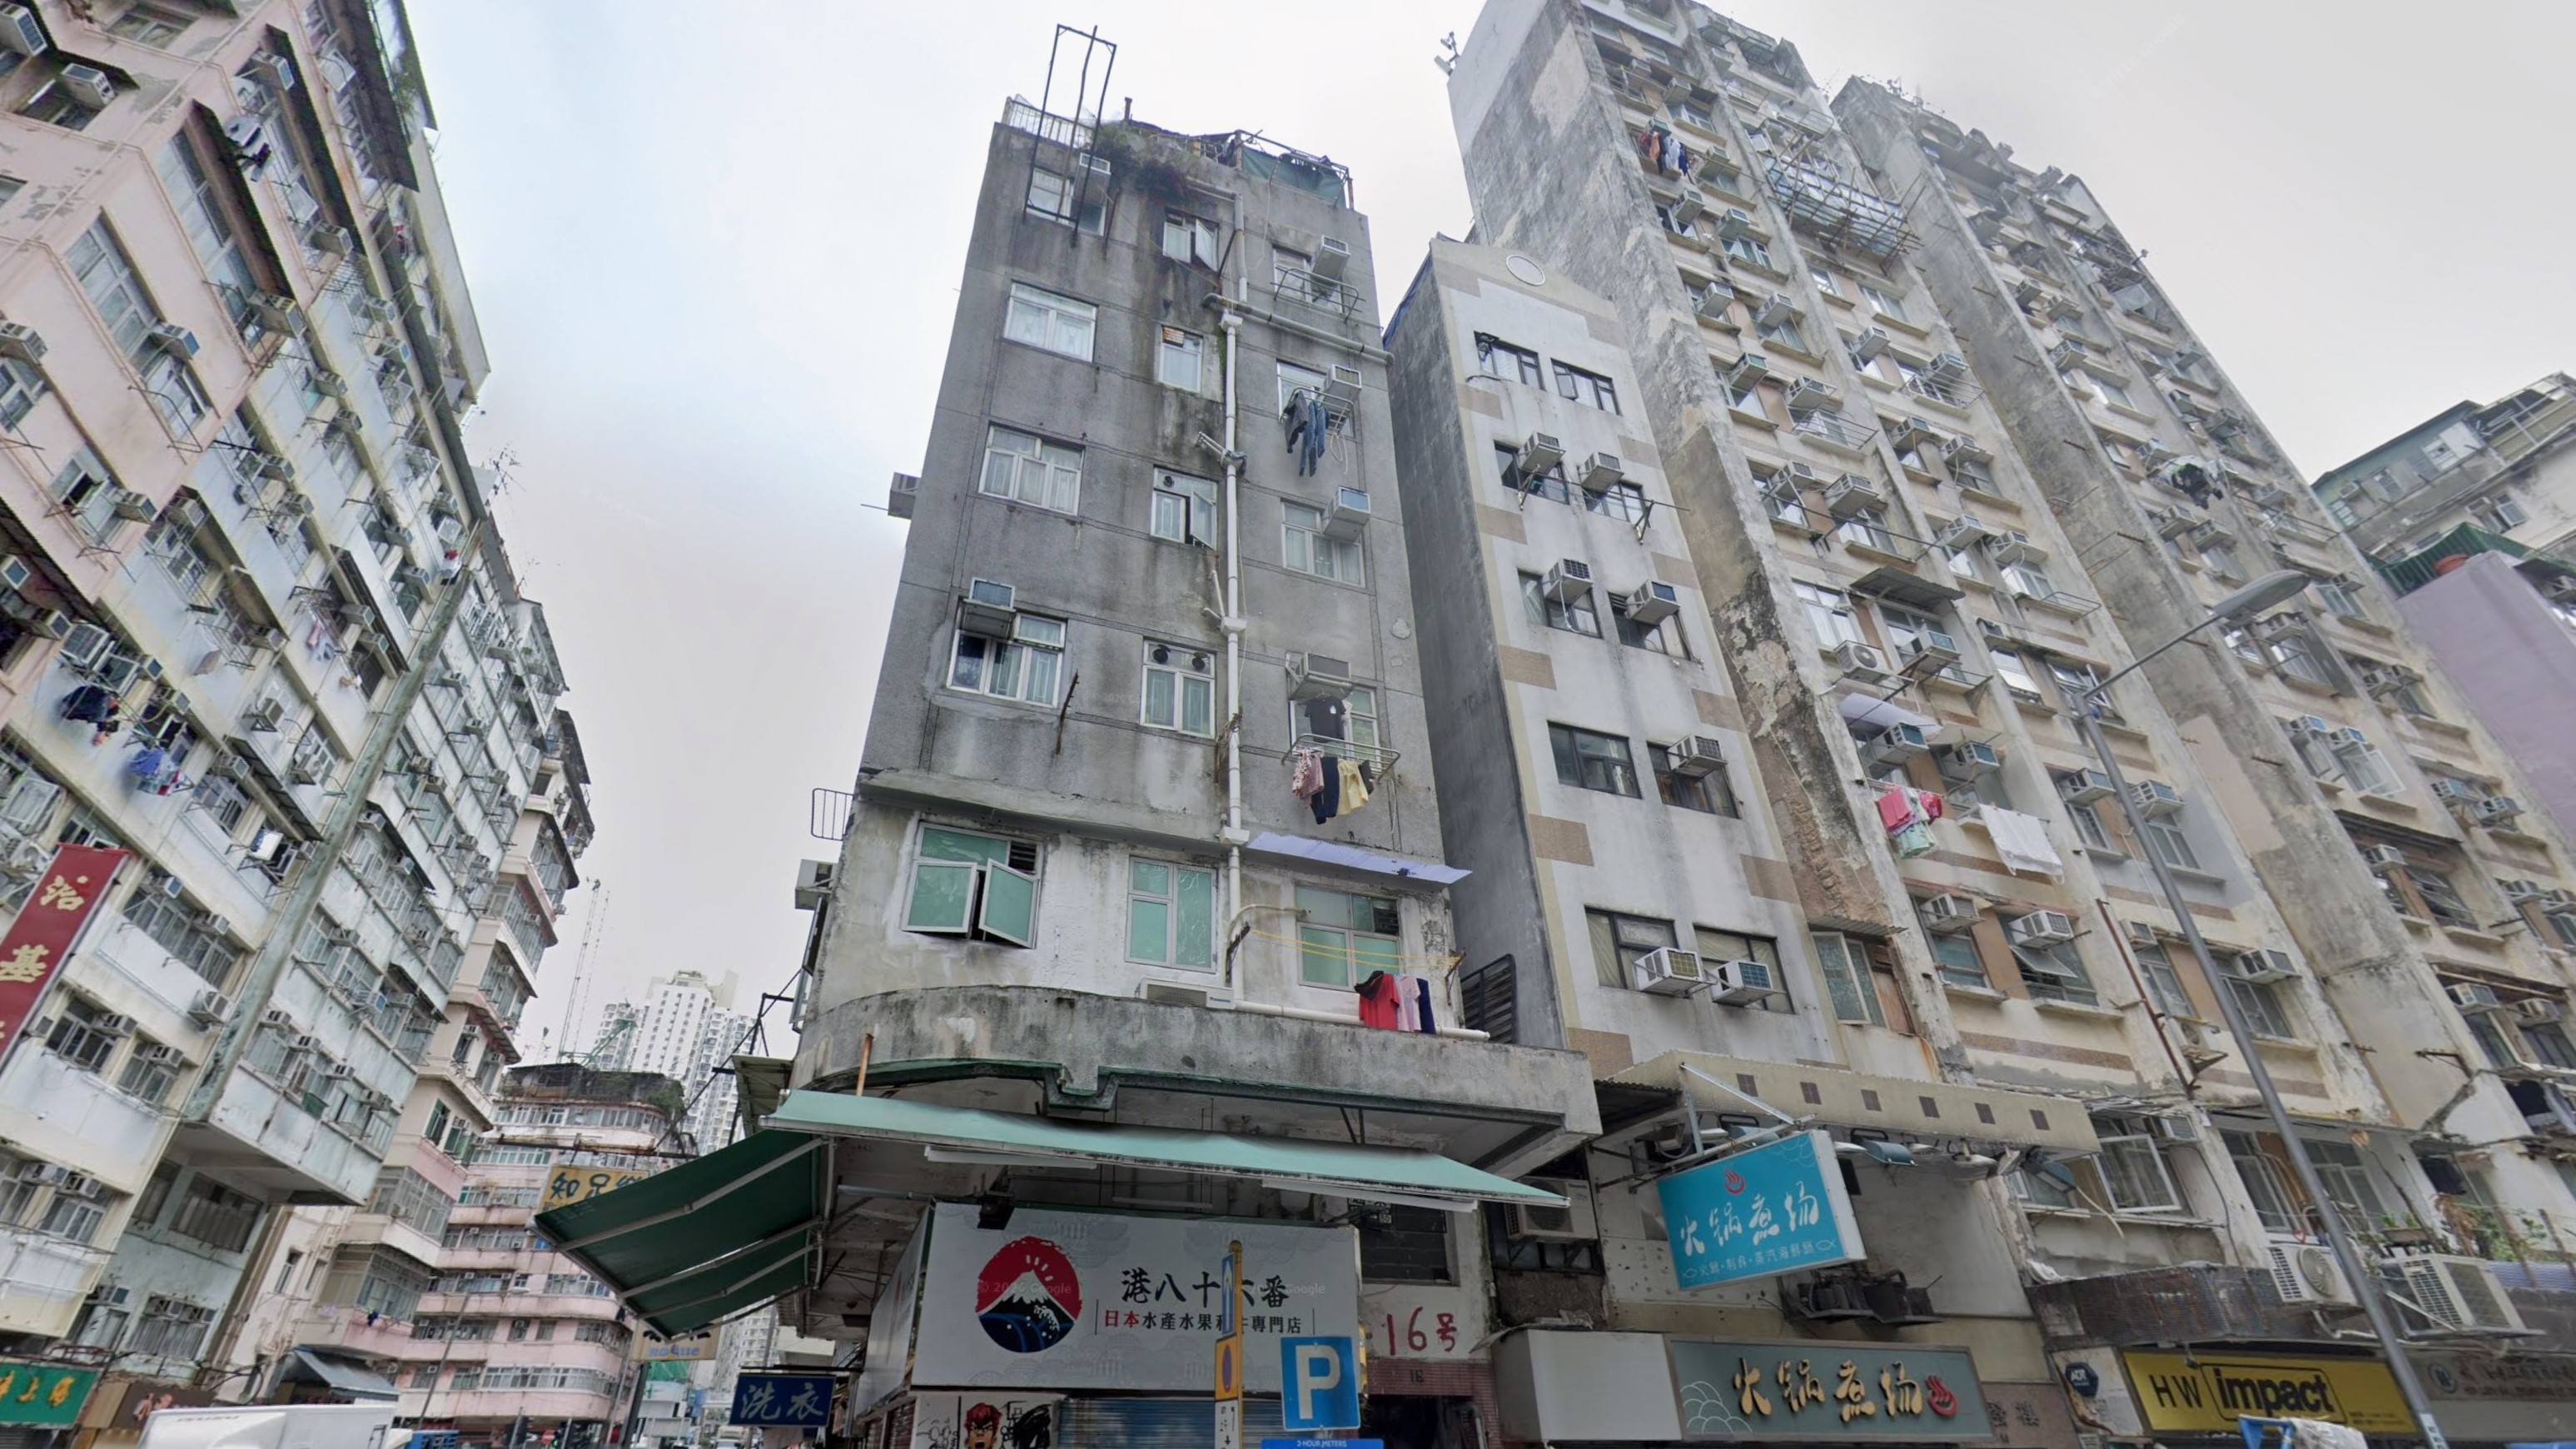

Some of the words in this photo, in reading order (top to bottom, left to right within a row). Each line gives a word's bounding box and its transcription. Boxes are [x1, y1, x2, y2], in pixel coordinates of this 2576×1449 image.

[1105, 1310, 1301, 1334] 日本水產水果專門店
[742, 1381, 827, 1421] 洗衣
[2213, 1367, 2335, 1417] impact
